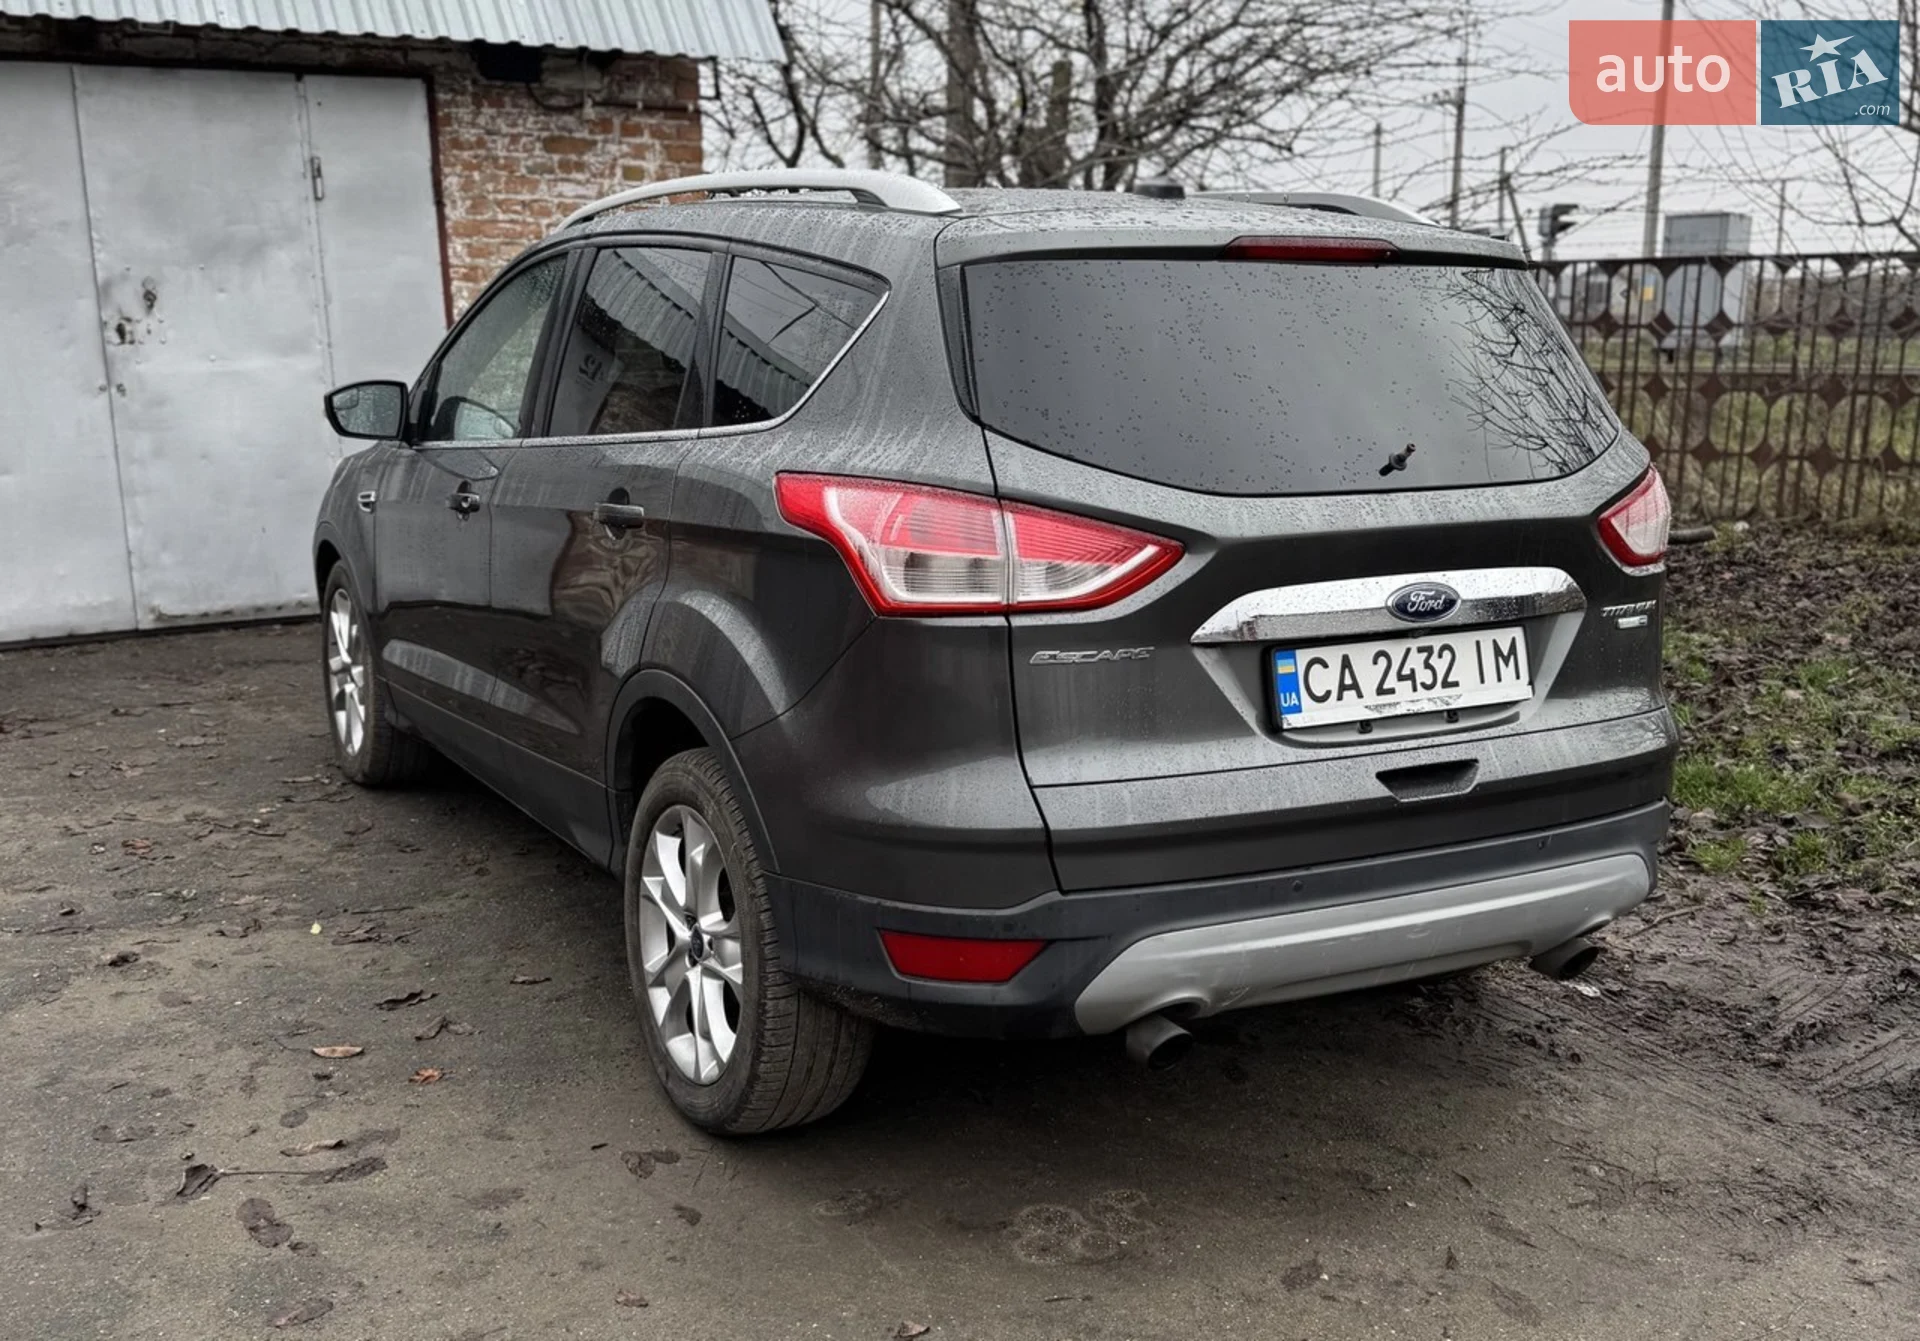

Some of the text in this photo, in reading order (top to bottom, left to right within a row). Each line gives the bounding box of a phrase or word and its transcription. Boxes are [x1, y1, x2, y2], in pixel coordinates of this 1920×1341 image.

[1407, 590, 1446, 612] Ford
[1029, 646, 1155, 664] ESCAPE
[1303, 636, 1521, 703] CA 2432 IM
[1281, 691, 1300, 708] UA
